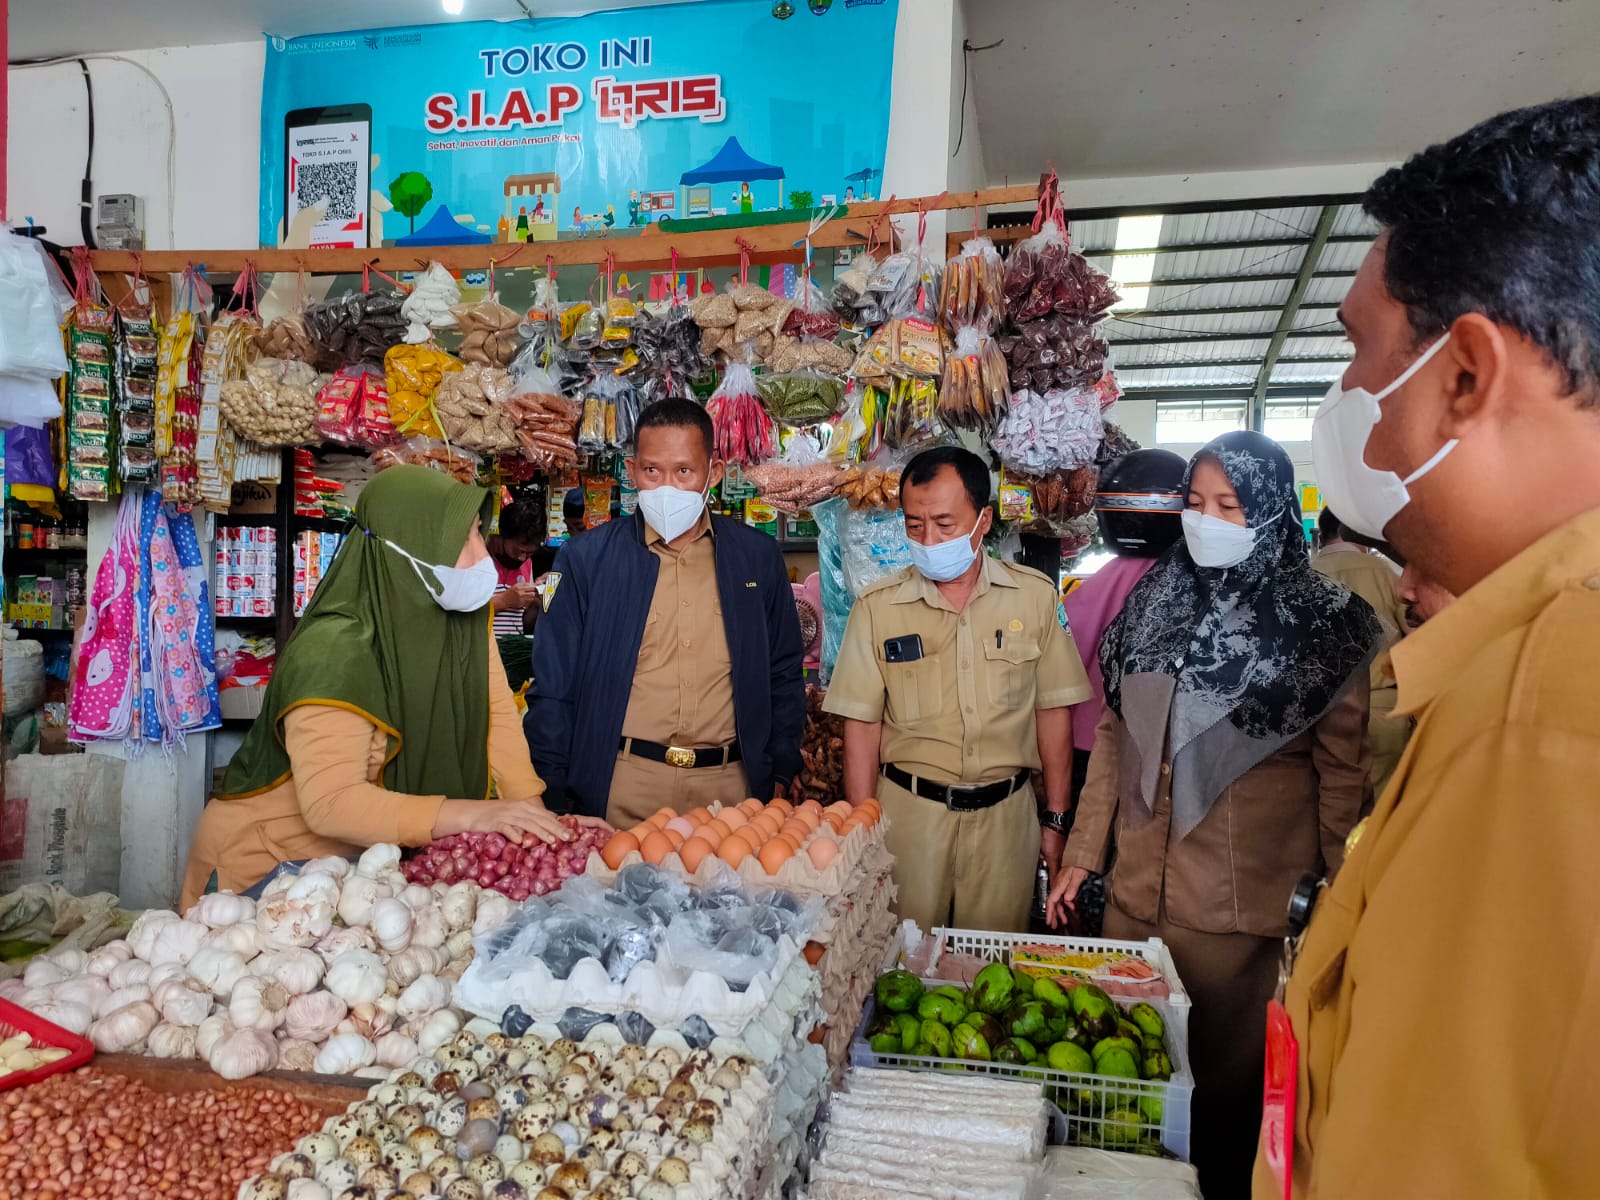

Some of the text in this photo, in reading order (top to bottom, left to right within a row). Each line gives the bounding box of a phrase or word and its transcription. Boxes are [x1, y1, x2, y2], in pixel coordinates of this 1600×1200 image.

[288, 39, 357, 51] BANK INDONESIA
[481, 38, 650, 77] TOKO INI
[427, 78, 718, 130] S.I.A.P QRIS
[428, 141, 458, 150] Sehat,
[460, 139, 497, 148] Inovatif
[498, 138, 519, 146] dan
[521, 136, 550, 145] Aman
[231, 485, 267, 506] ajiku
